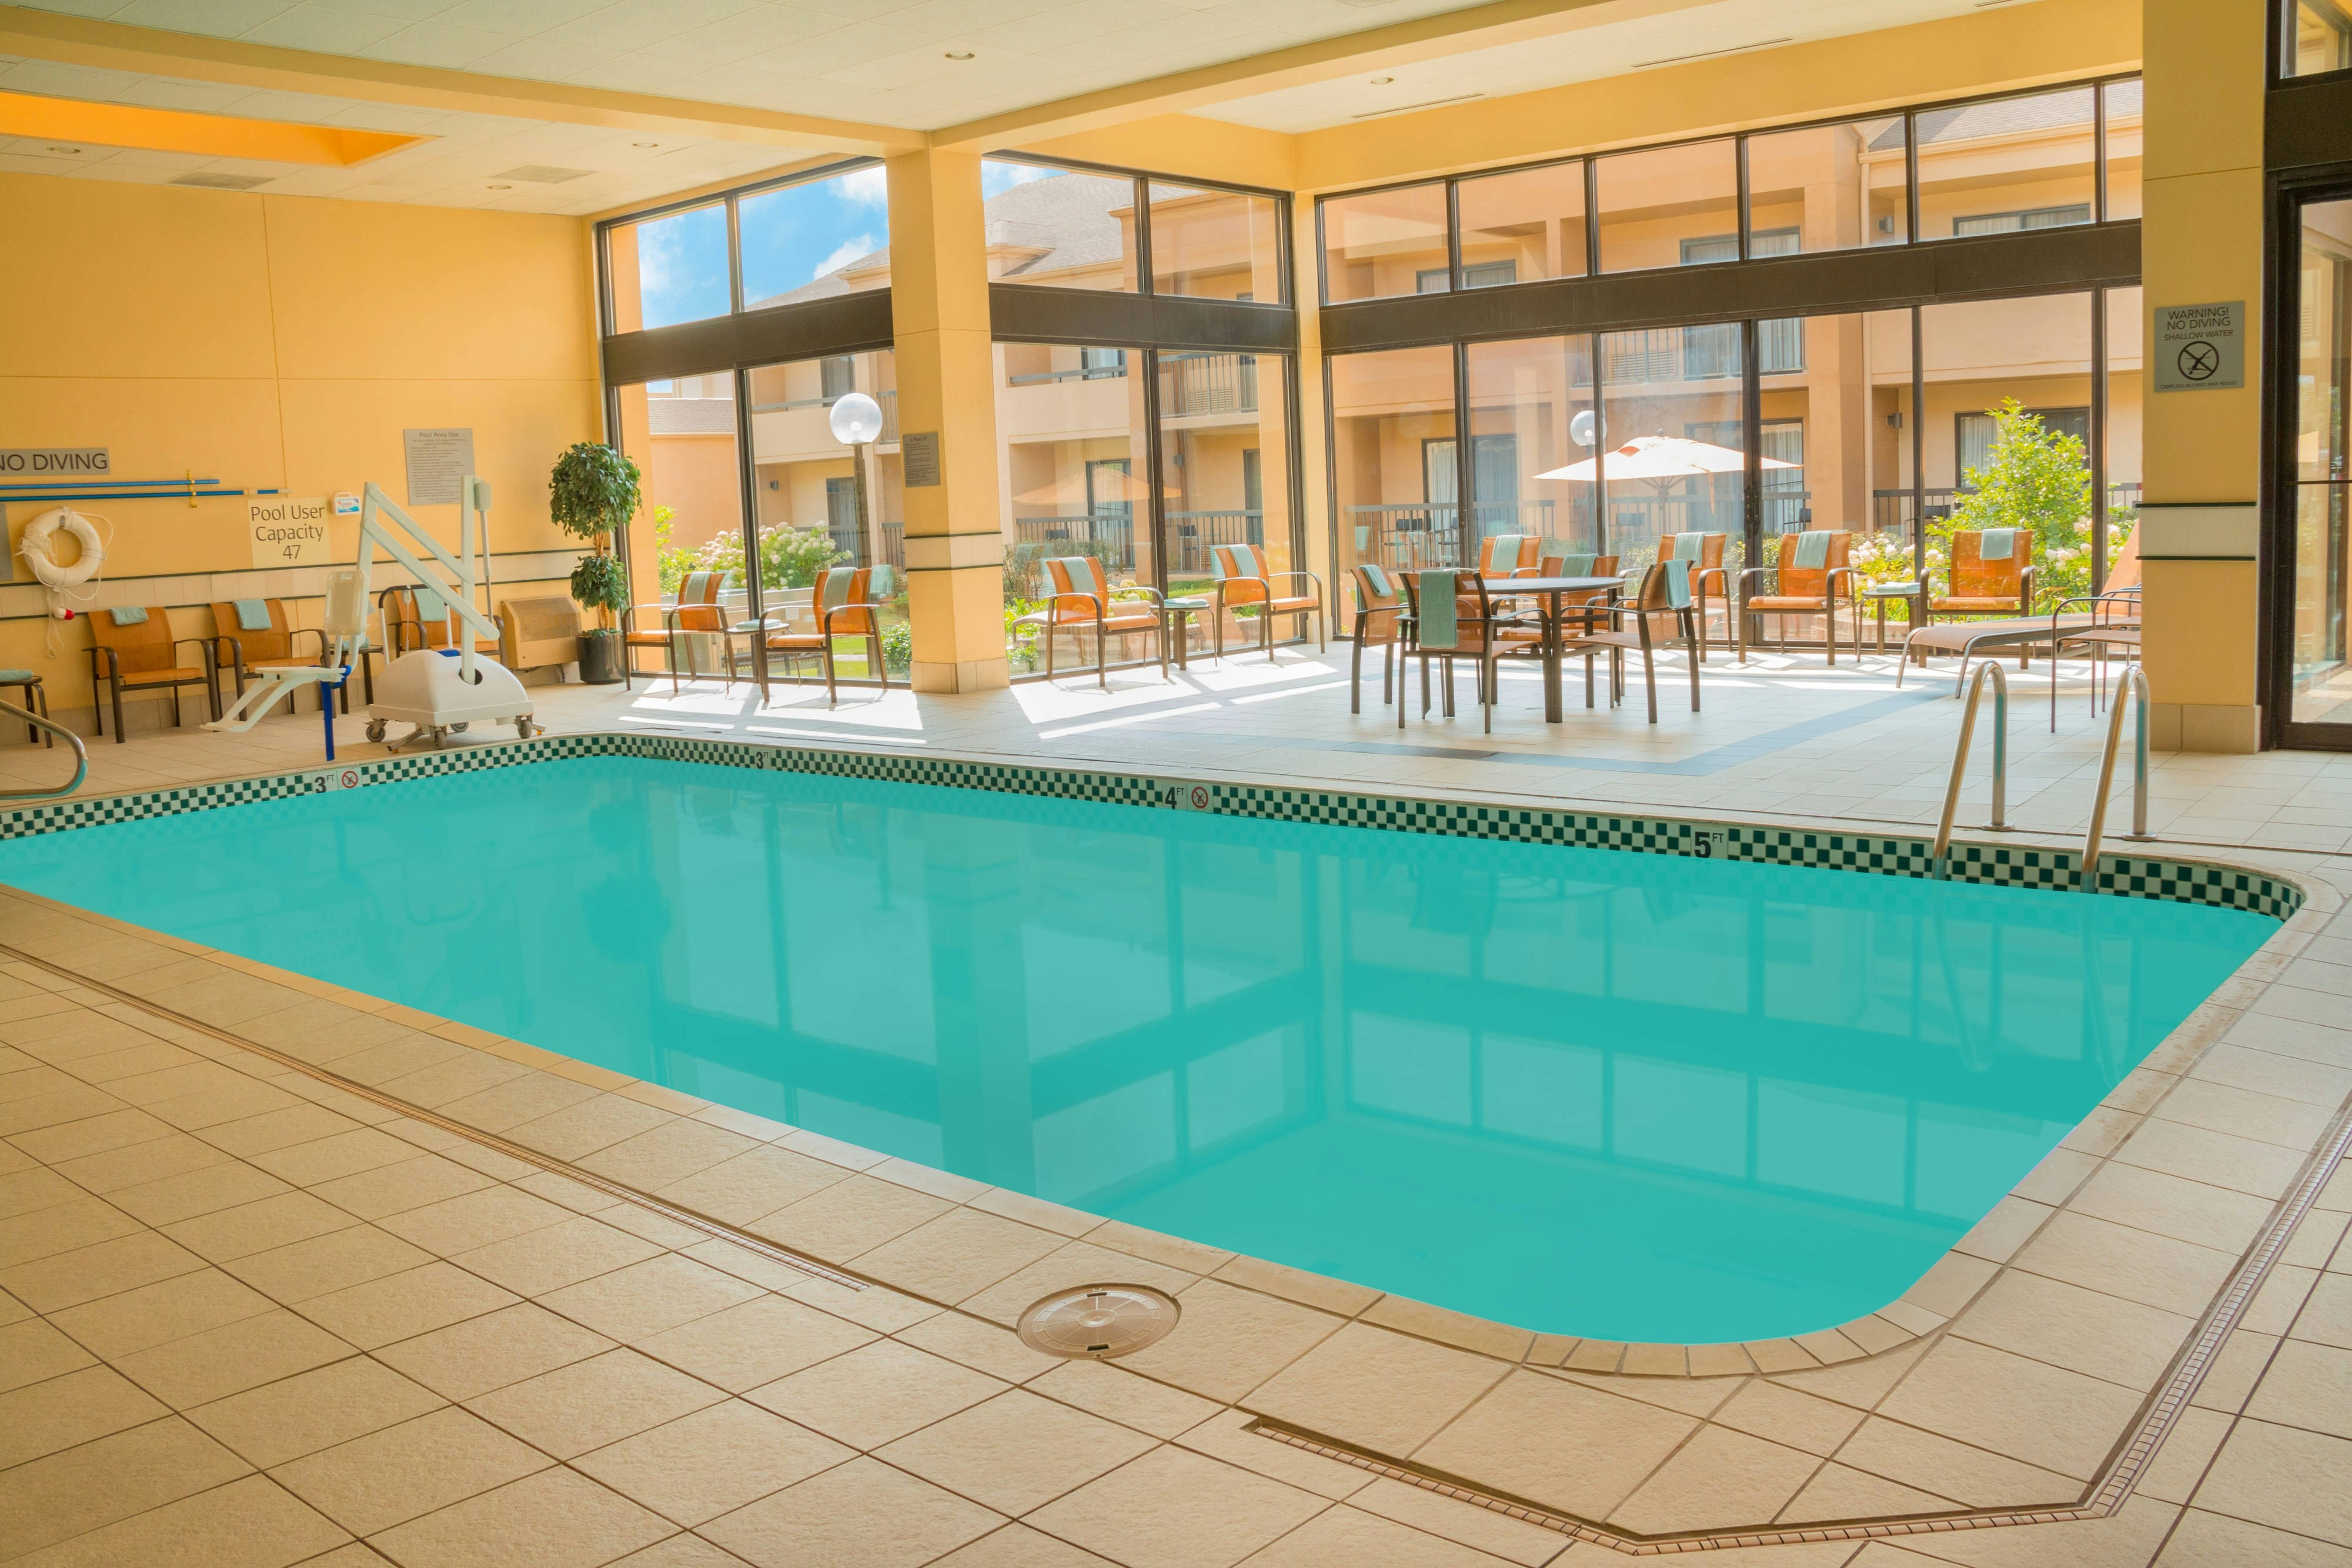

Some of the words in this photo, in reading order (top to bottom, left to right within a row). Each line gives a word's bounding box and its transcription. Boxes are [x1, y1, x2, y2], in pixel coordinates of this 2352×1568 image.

[2168, 306, 2229, 320] WARNING!
[2167, 320, 2186, 330] NO
[2190, 317, 2230, 329] DIVING
[2164, 332, 2204, 341] SHALLOW
[2206, 329, 2234, 338] WATER
[33, 453, 108, 470] DIVING
[250, 504, 286, 521] Pool
[291, 504, 325, 520] User
[256, 523, 323, 544] Capacity
[283, 544, 301, 560] 47
[756, 751, 764, 769] 3
[315, 776, 326, 794] 3
[1165, 787, 1177, 810] 4
[1177, 787, 1185, 796] FT
[1694, 831, 1712, 858] 5
[1712, 832, 1724, 843] FT
